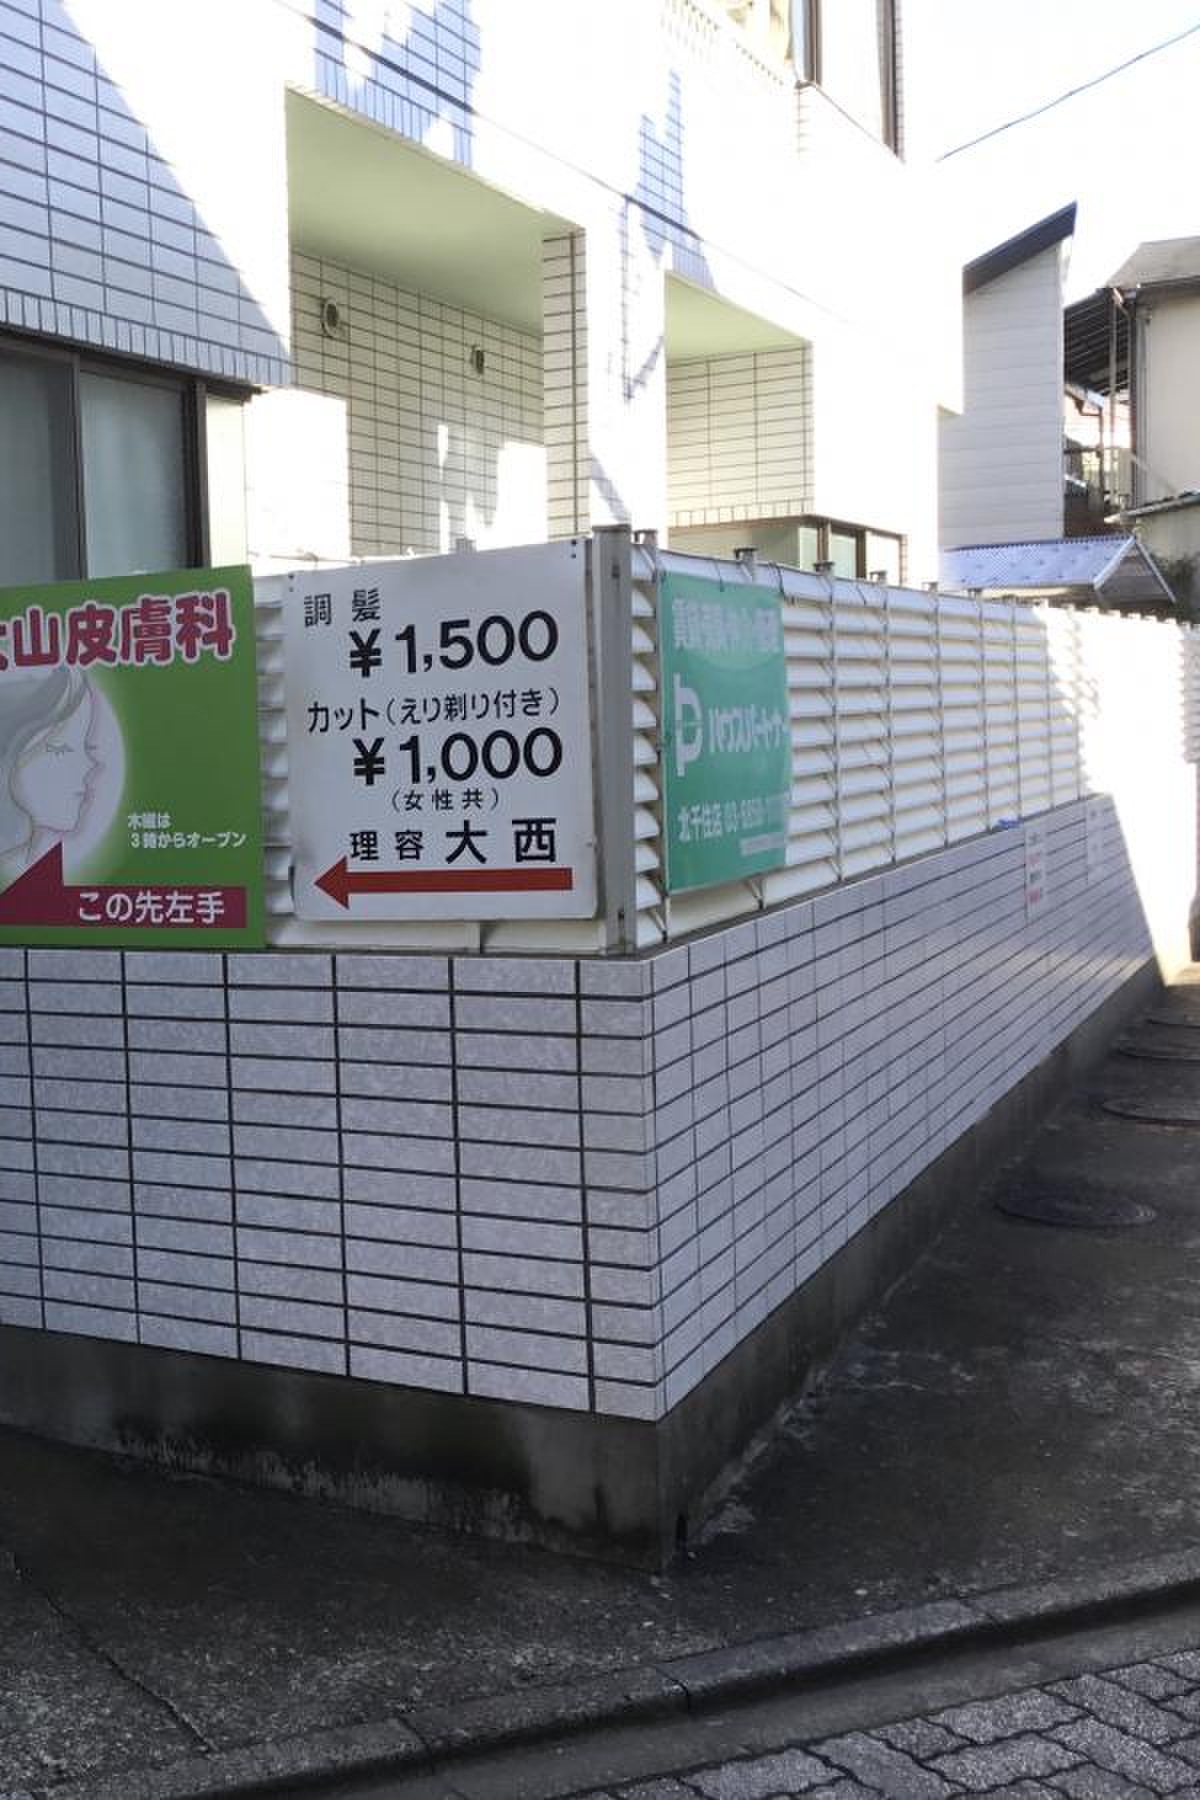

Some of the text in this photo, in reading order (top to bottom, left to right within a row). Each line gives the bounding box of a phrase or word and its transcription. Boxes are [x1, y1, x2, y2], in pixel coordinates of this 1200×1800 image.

[304, 588, 381, 627] 調髪
[349, 610, 559, 678] ¥1,500
[353, 727, 563, 786] ¥1,000
[79, 891, 225, 924] この先左手
